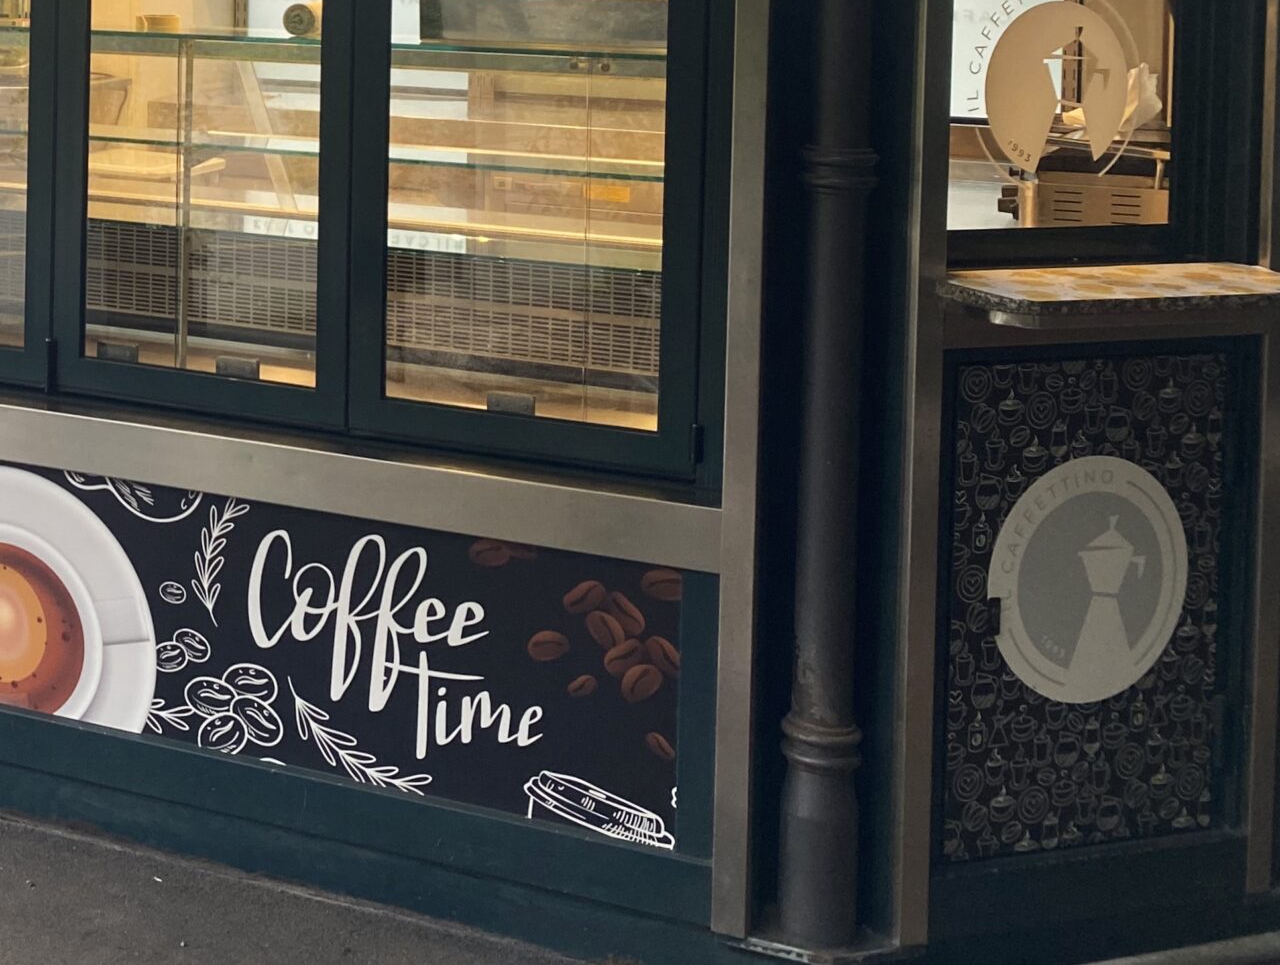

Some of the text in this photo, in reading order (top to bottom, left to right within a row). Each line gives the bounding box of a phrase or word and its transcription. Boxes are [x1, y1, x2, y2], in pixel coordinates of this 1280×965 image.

[966, 89, 979, 112] IL
[1001, 469, 1115, 574] CAFFETTINO
[248, 529, 490, 713] Coffee
[383, 650, 543, 760] Time
